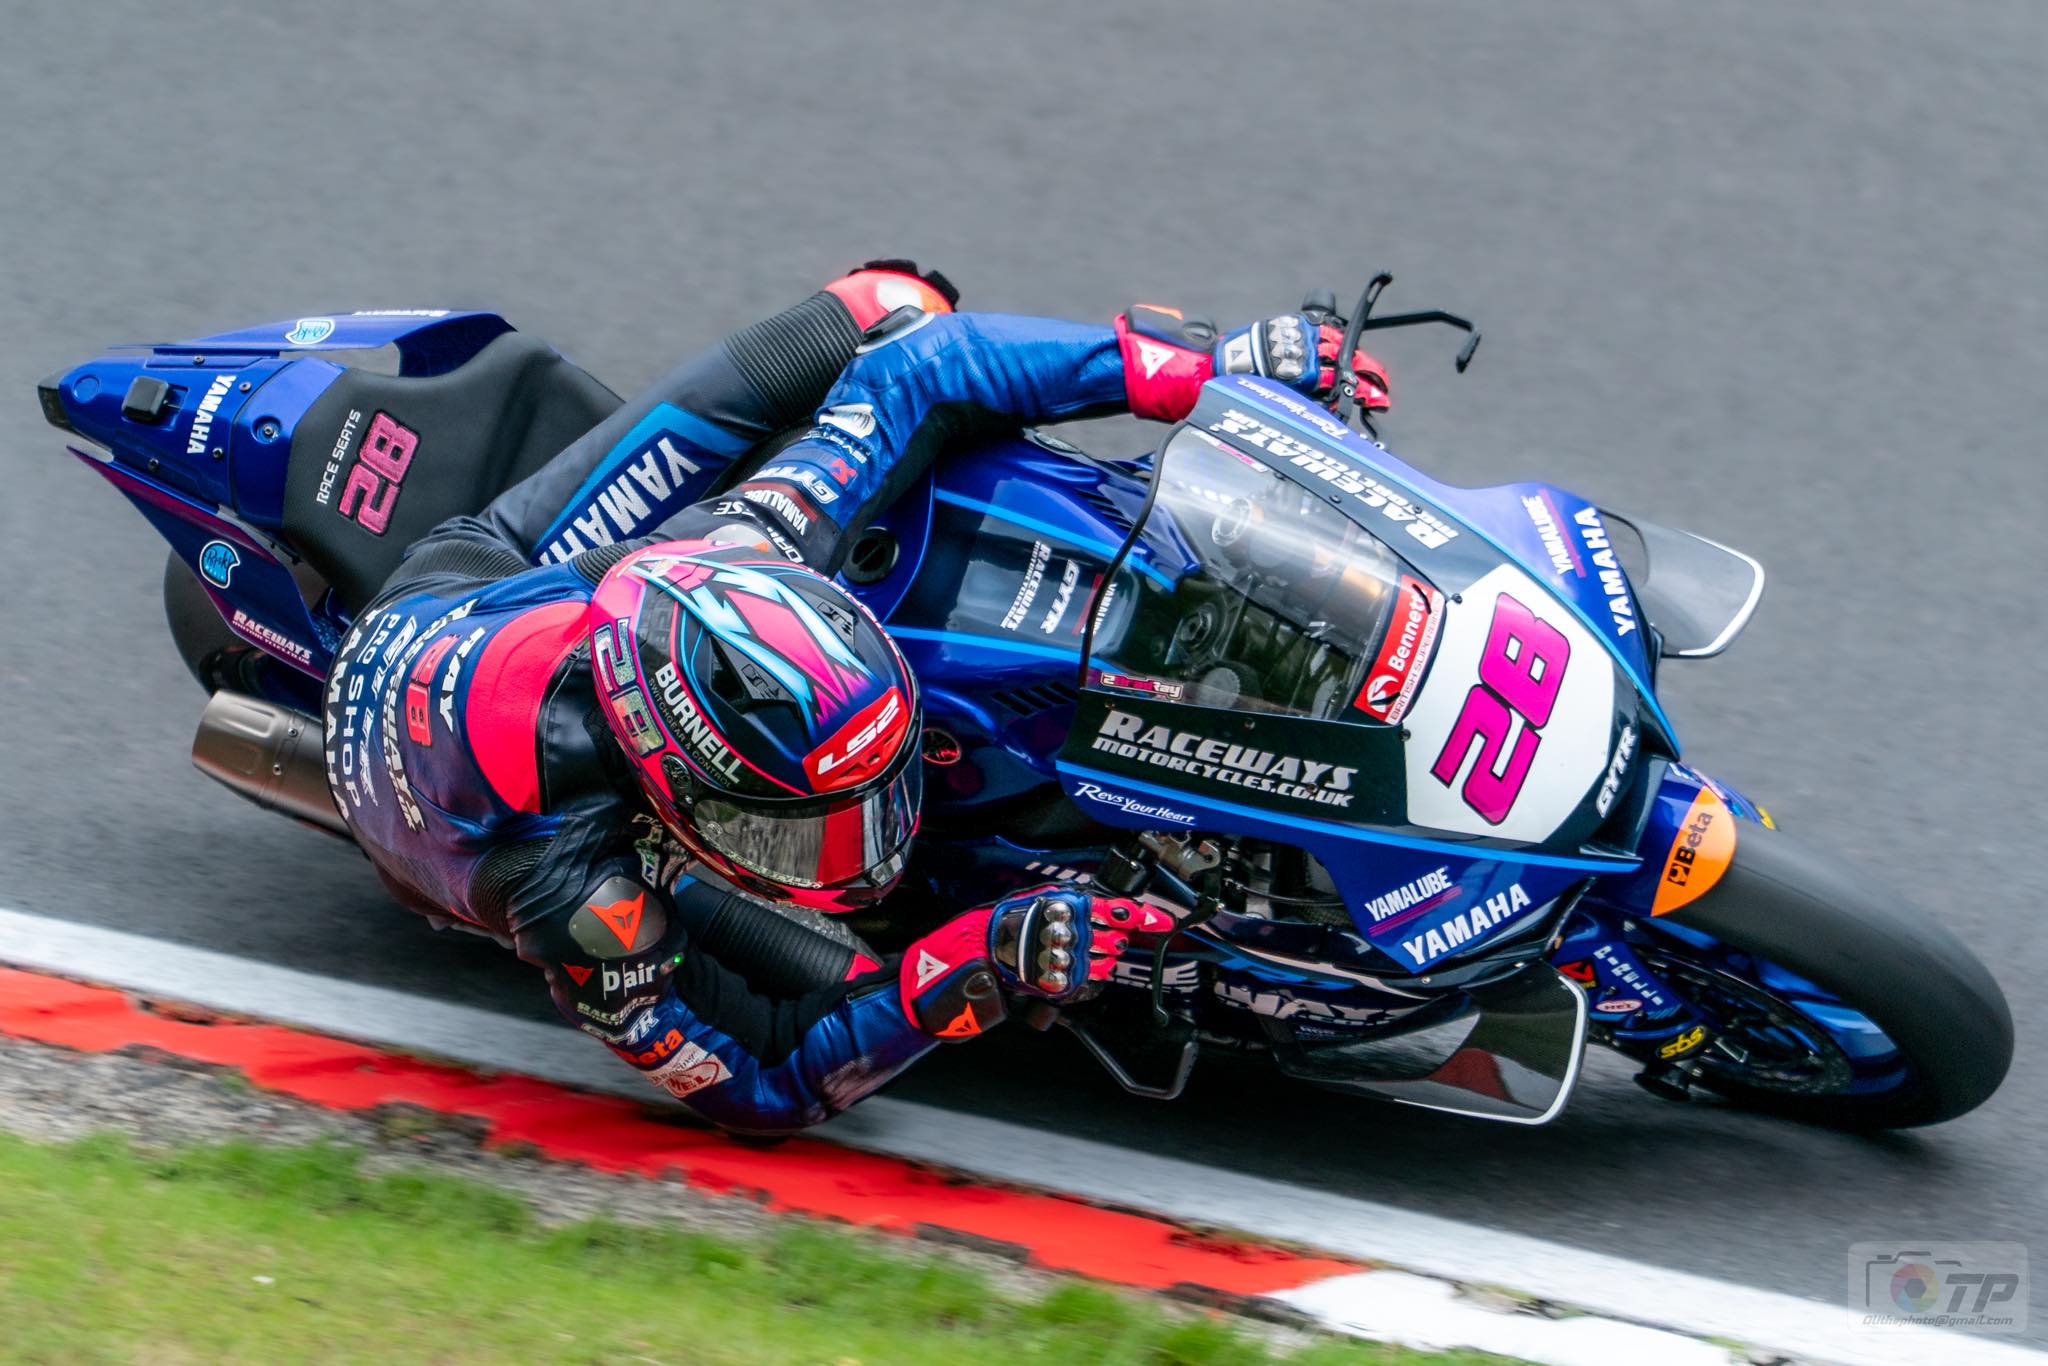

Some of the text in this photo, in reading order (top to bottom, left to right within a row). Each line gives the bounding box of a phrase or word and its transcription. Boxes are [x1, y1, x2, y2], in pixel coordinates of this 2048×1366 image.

[187, 375, 237, 454] YAMAHA
[316, 408, 361, 505] RACE SEATS
[339, 411, 419, 534] 28
[540, 437, 701, 566] YAMAH
[744, 489, 808, 536] YAMALUBE
[1216, 418, 1450, 549] RACEWAYS
[1521, 495, 1575, 575] YAMALUBE
[1574, 507, 1636, 636] YAMAHA
[1008, 543, 1052, 631] RACEWAYS
[1040, 559, 1080, 633] GYTR
[1387, 587, 1430, 671] Bennett
[233, 609, 312, 660] RACEWAYS
[362, 613, 401, 665] PRO
[326, 602, 393, 820] YAMAHA
[594, 617, 665, 757] 28
[655, 661, 741, 784] BURNELL
[1389, 671, 1417, 722] BRITISH
[1430, 592, 1571, 826] 28
[342, 674, 370, 807] SHOP
[649, 678, 686, 742] SWITCHGEAR
[691, 750, 732, 788] CONTROL
[817, 694, 900, 776] LS2
[1092, 737, 1354, 808] MOTORCYCLES.CO.UK
[1099, 710, 1358, 791] RACEWAYS
[1596, 726, 1637, 818] GYTR
[1675, 812, 1713, 865] Beta
[1364, 866, 1452, 922] YAMALUBE
[1402, 882, 1532, 966] YAMAHA
